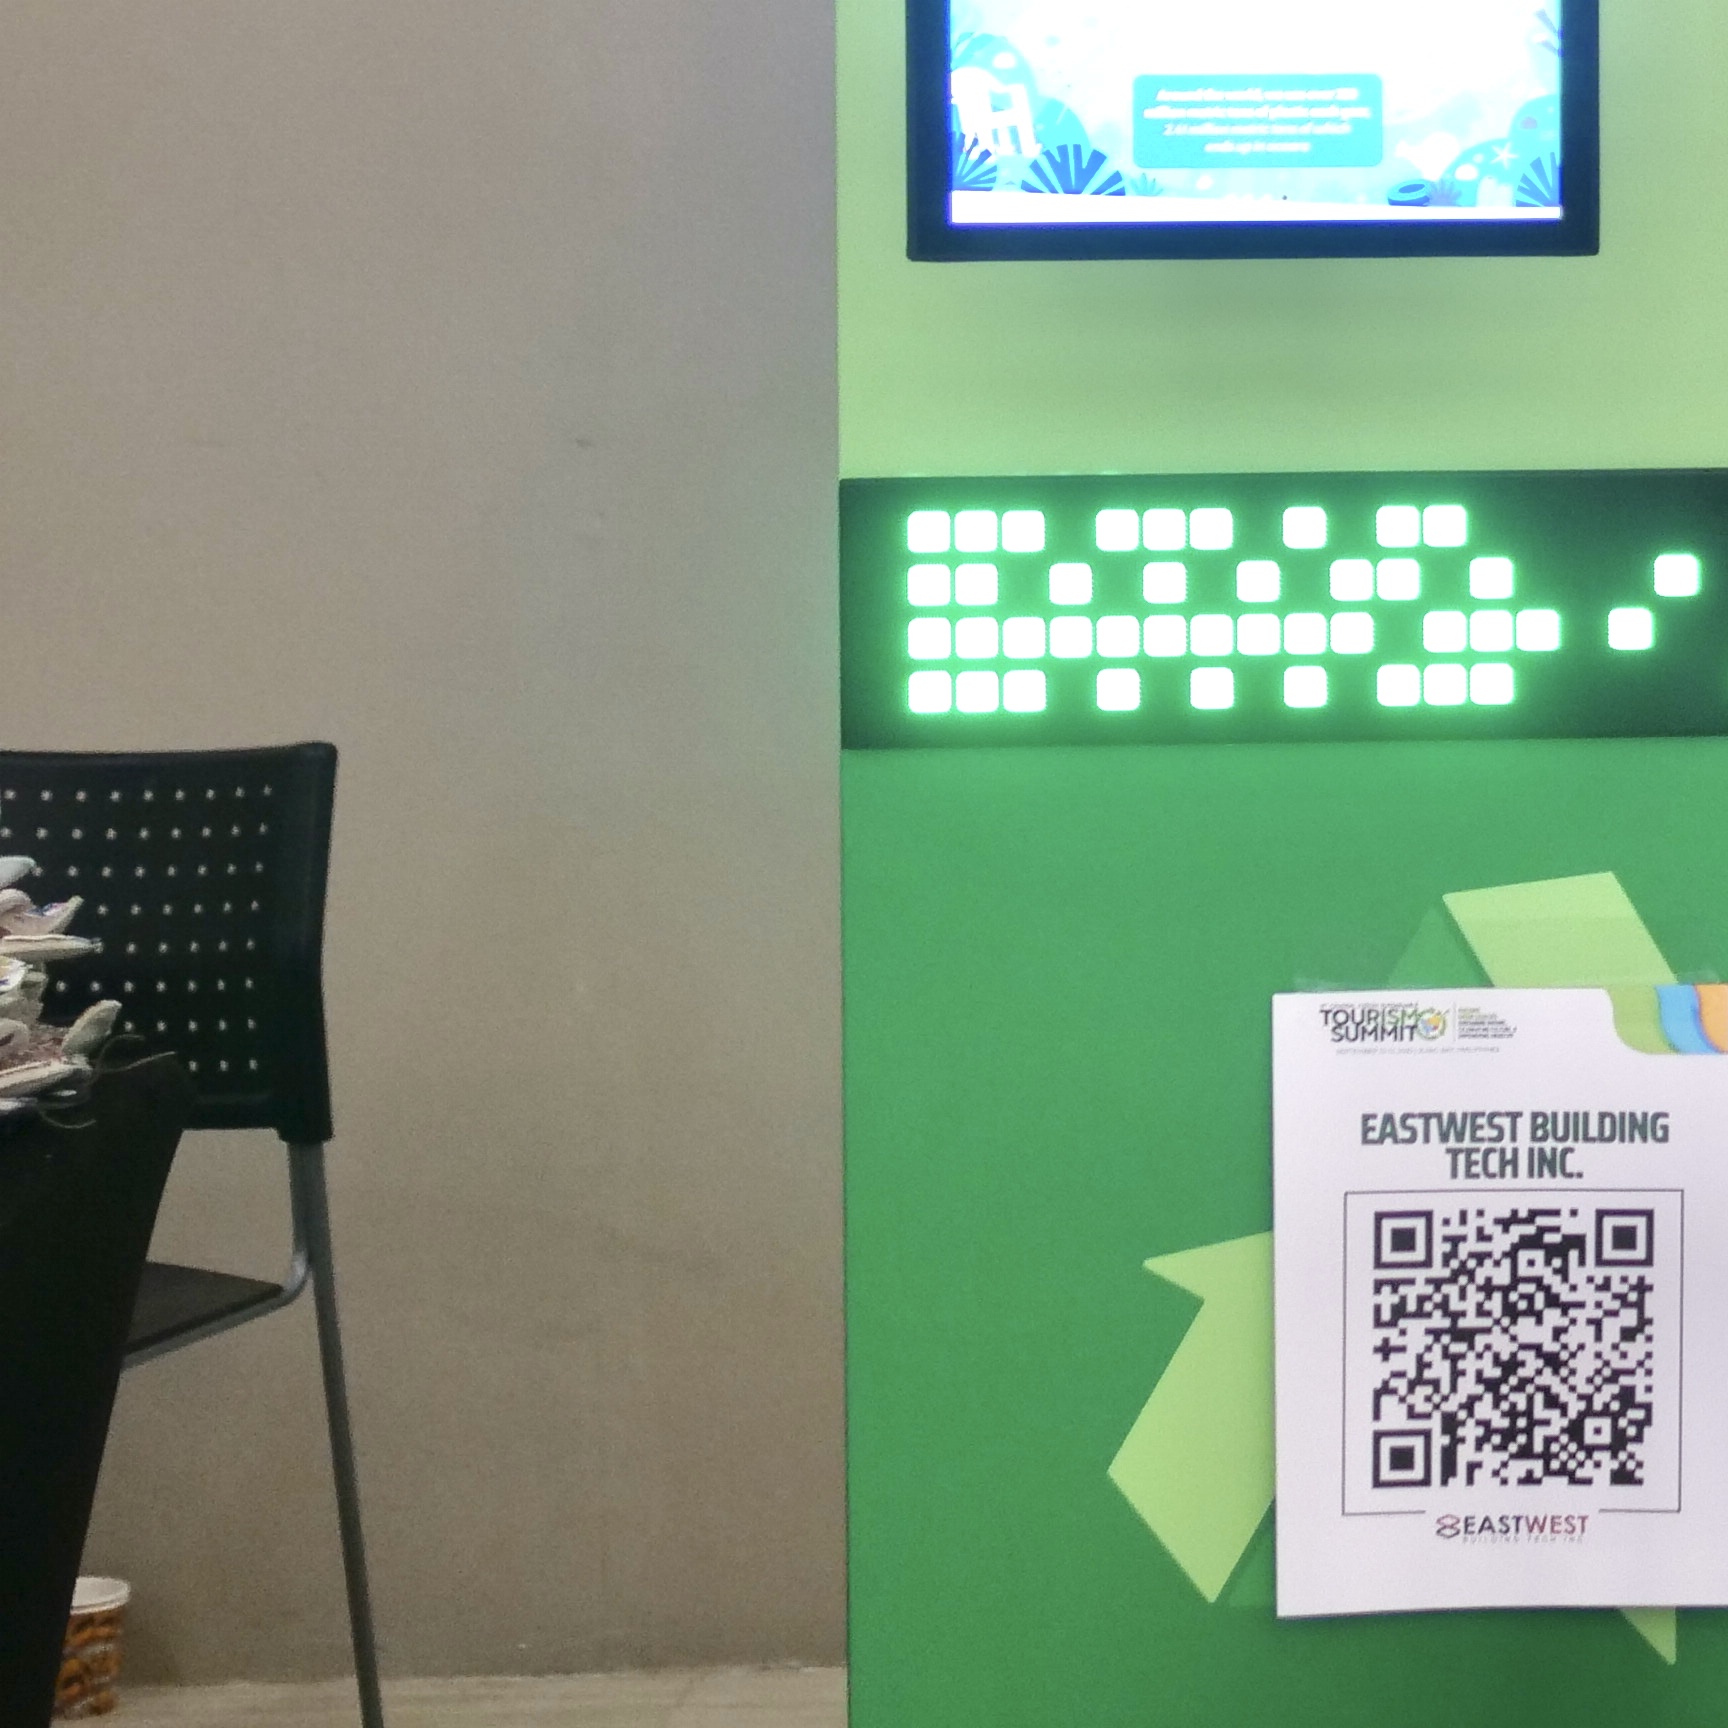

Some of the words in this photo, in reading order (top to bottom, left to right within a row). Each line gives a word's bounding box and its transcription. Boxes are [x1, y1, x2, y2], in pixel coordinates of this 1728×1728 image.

[1320, 1008, 1418, 1025] TOURISM
[1331, 1024, 1417, 1043] SUMMIT
[1361, 1111, 1523, 1146] EASTWEST
[1530, 1111, 1670, 1144] BUILDING
[1446, 1147, 1519, 1180] TECH
[1527, 1146, 1584, 1179] INC.
[1463, 1514, 1590, 1536] EASTWEST
